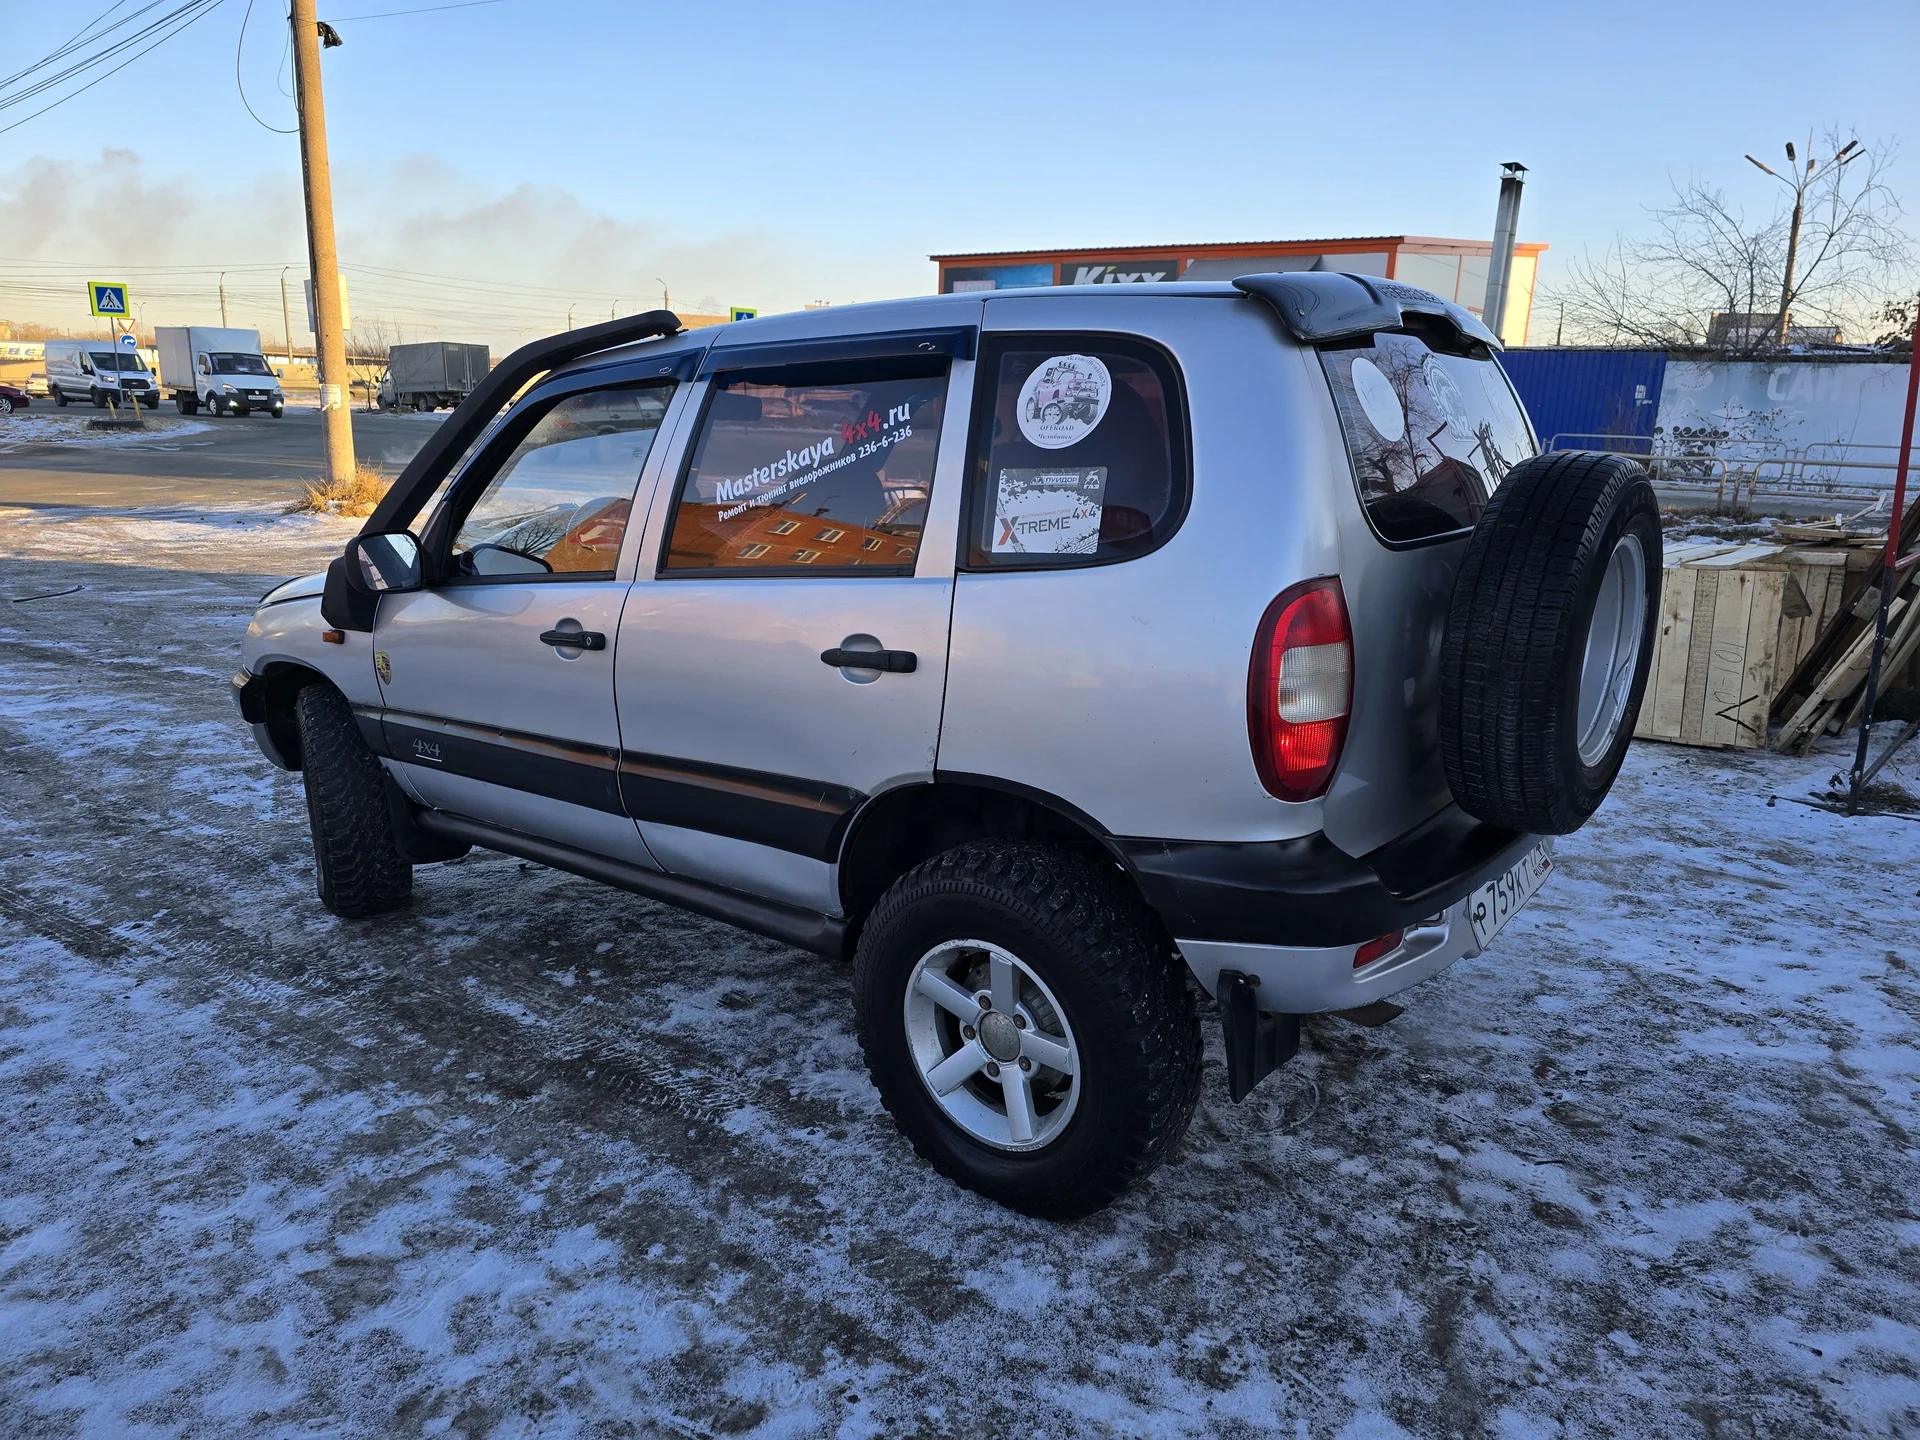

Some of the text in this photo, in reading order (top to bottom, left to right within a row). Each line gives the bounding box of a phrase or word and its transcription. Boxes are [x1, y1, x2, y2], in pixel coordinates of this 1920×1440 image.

[1073, 266, 1167, 285] Kixx
[715, 402, 911, 505] Masterskaya 4x4.ru
[717, 425, 912, 522] Ремонт и тюнинг внедорожников 236-6-236
[998, 516, 1071, 546] X-TREME
[412, 738, 441, 757] 4x4
[1533, 863, 1545, 879] RUS
